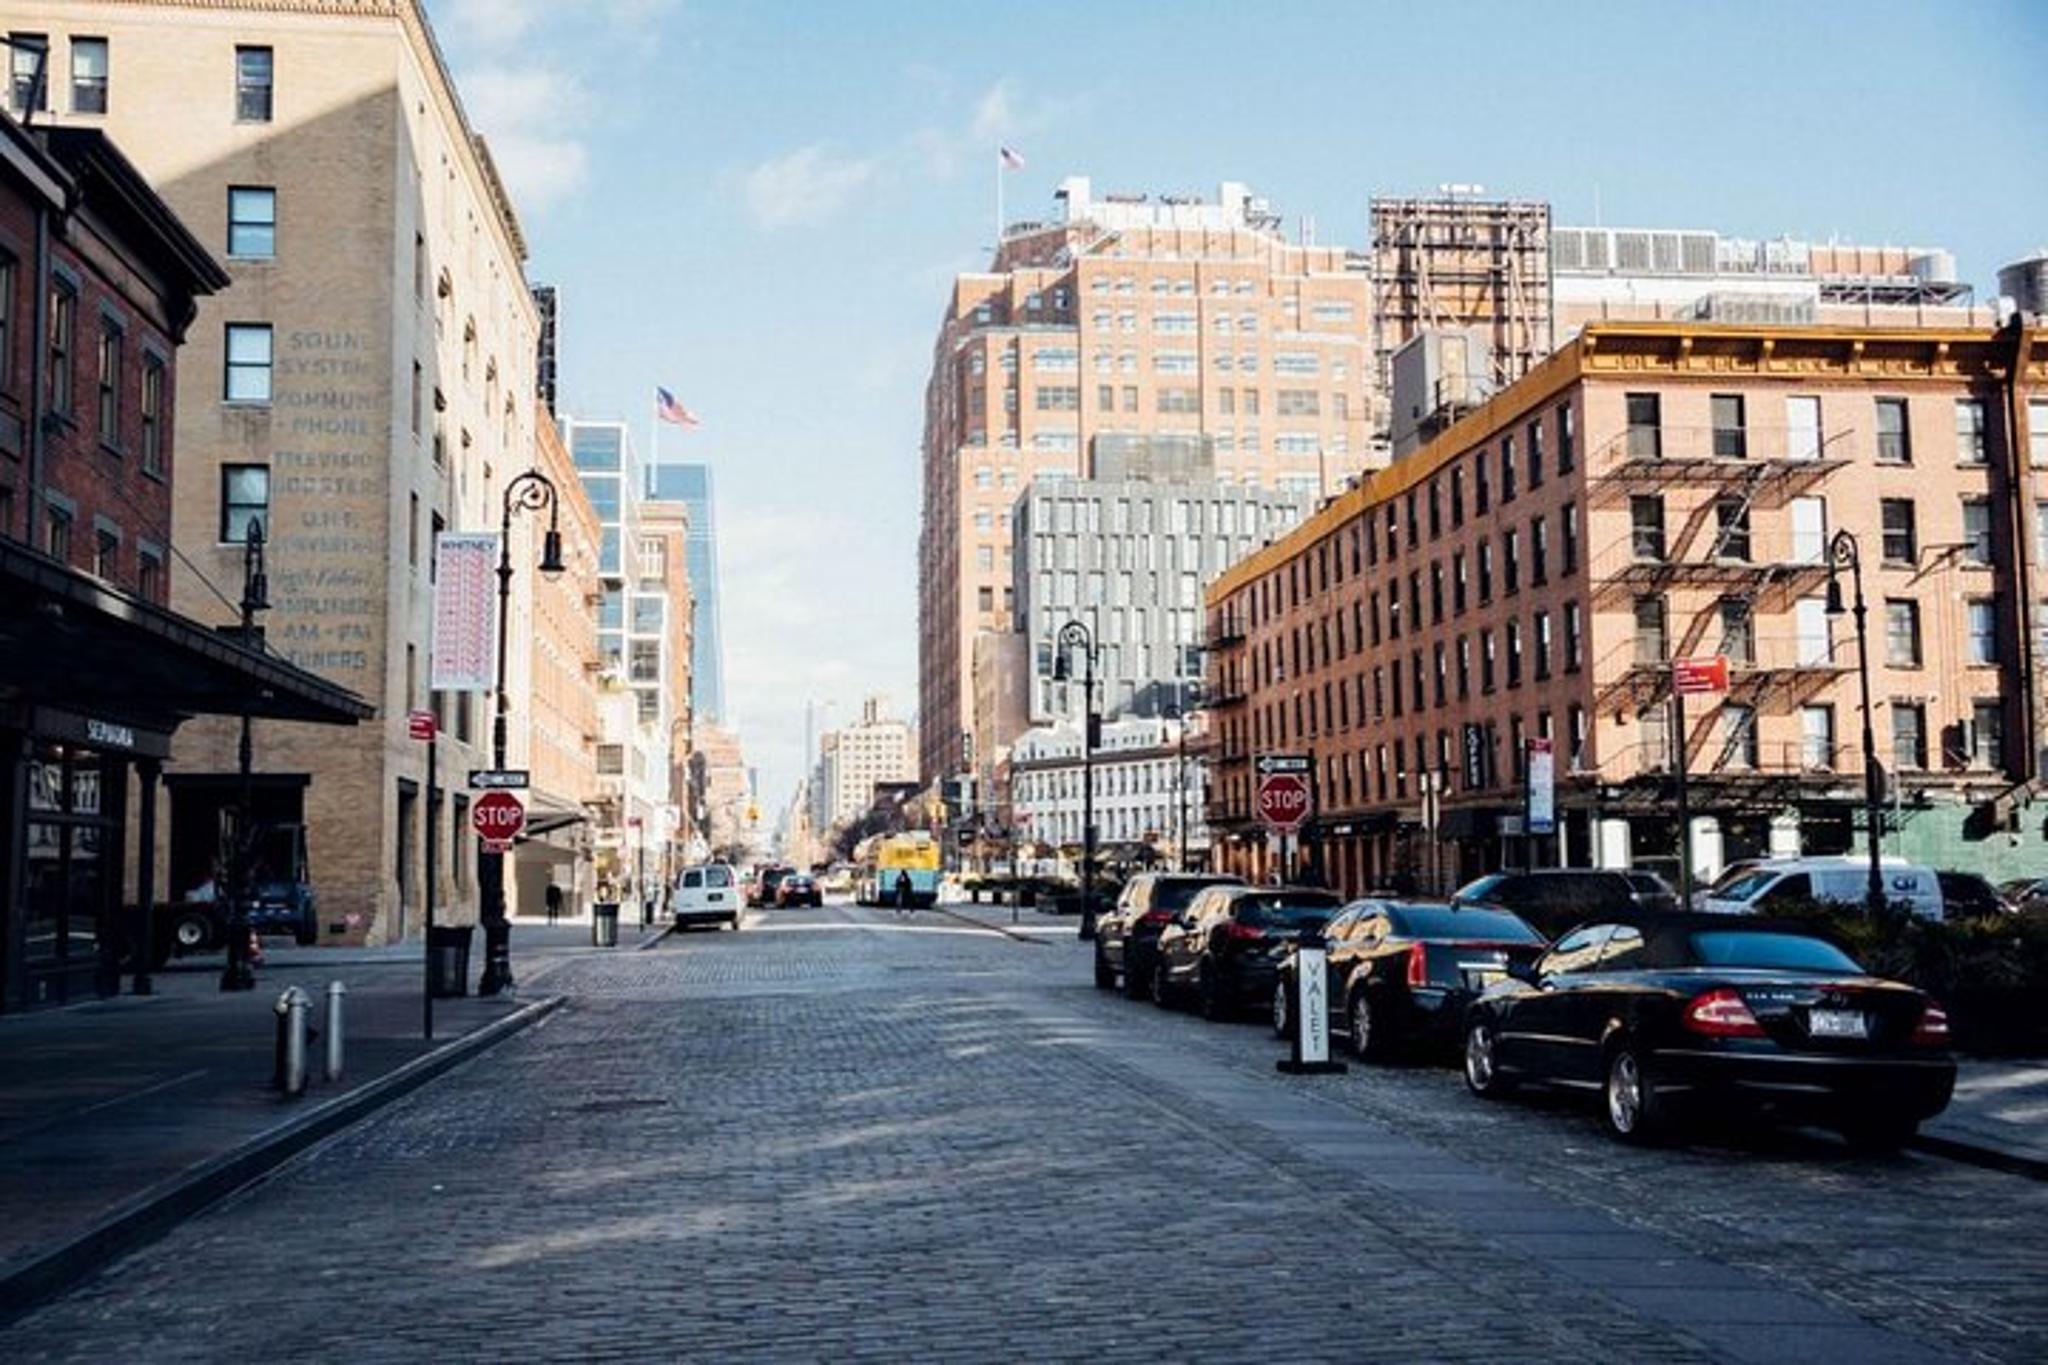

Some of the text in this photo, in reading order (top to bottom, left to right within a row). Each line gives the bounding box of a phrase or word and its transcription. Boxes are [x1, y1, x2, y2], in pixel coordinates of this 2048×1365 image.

[440, 540, 496, 552] WHITNEY
[1262, 789, 1305, 809] STOP
[475, 807, 521, 826] STOP
[1307, 960, 1322, 1053] VALET
